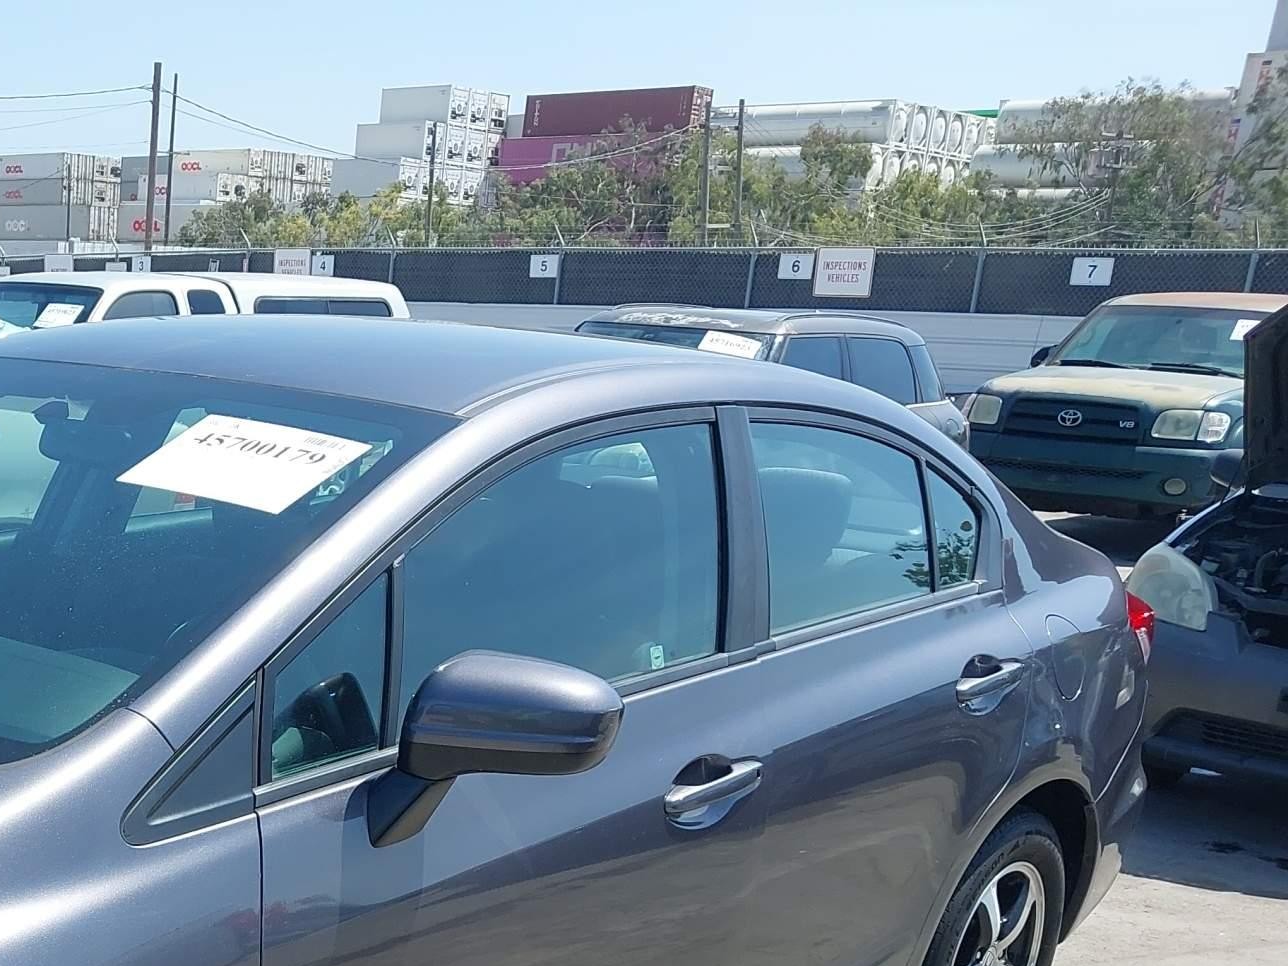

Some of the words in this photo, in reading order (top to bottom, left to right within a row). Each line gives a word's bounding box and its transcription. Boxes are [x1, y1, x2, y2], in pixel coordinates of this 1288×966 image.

[5, 165, 23, 174] OOCL
[181, 162, 202, 171] OOCL
[133, 220, 160, 232] OOL
[138, 261, 144, 271] 3
[319, 260, 326, 271] 4
[540, 260, 548, 272] 5
[791, 259, 801, 273] 6
[822, 261, 867, 271] INSPECTIONS
[1086, 264, 1099, 279] 7
[827, 273, 860, 283] VEHICLES
[1119, 420, 1135, 428] V8
[193, 432, 327, 465] 45700179
